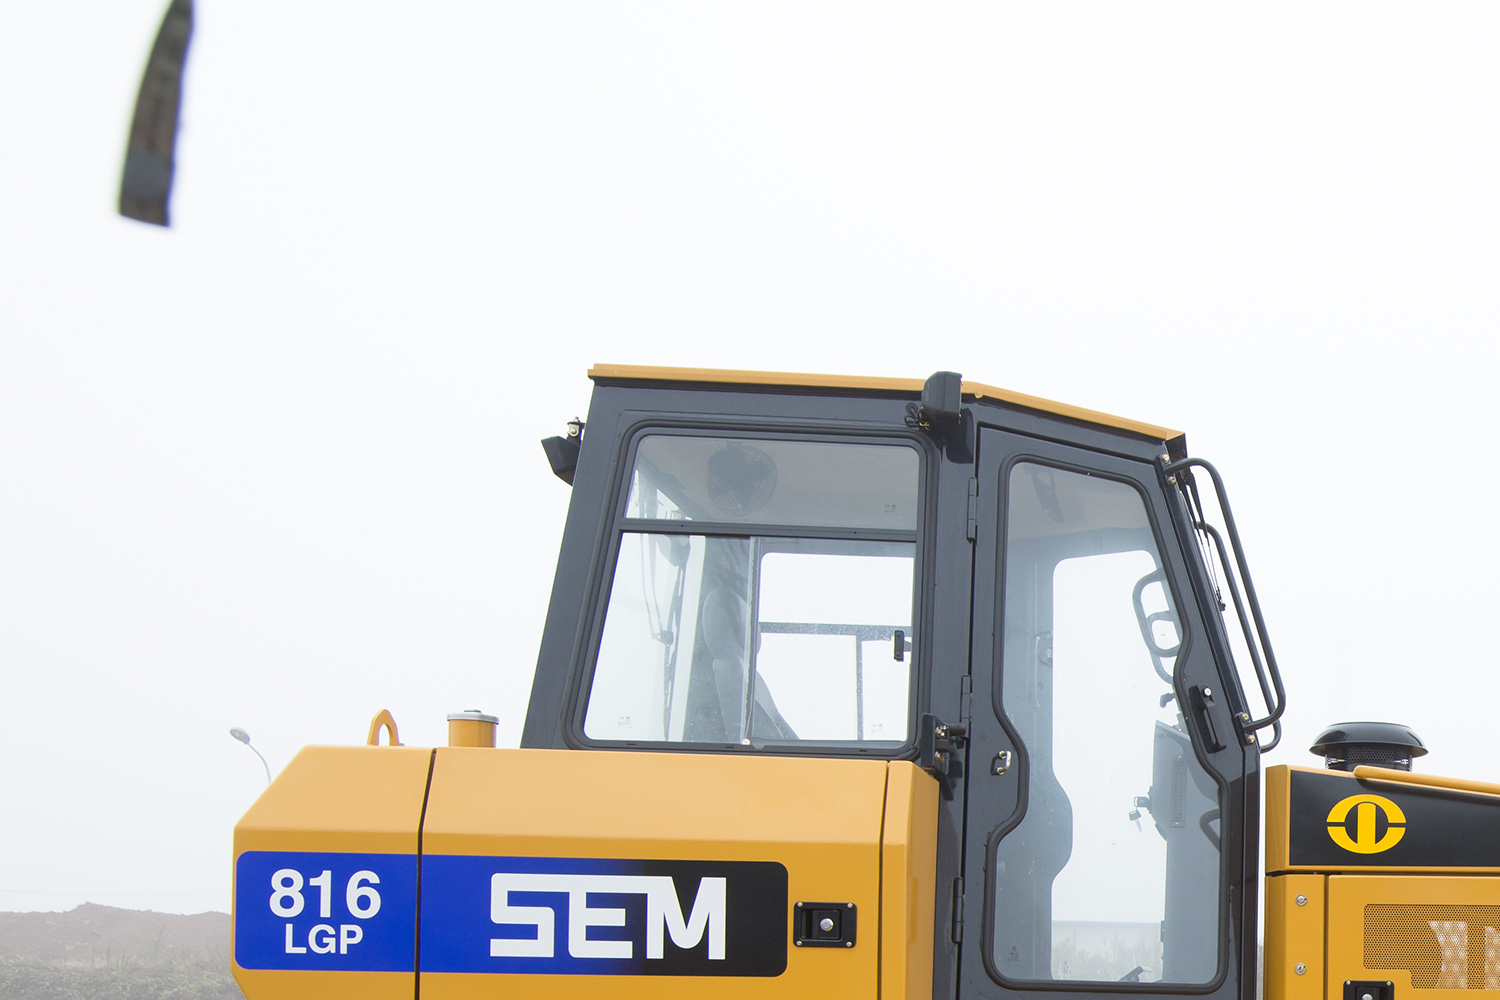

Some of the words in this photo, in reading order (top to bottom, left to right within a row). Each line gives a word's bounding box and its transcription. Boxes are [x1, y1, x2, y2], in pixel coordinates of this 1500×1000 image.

[269, 868, 381, 920] 816
[490, 873, 726, 960] SEM
[285, 923, 364, 955] LGP
